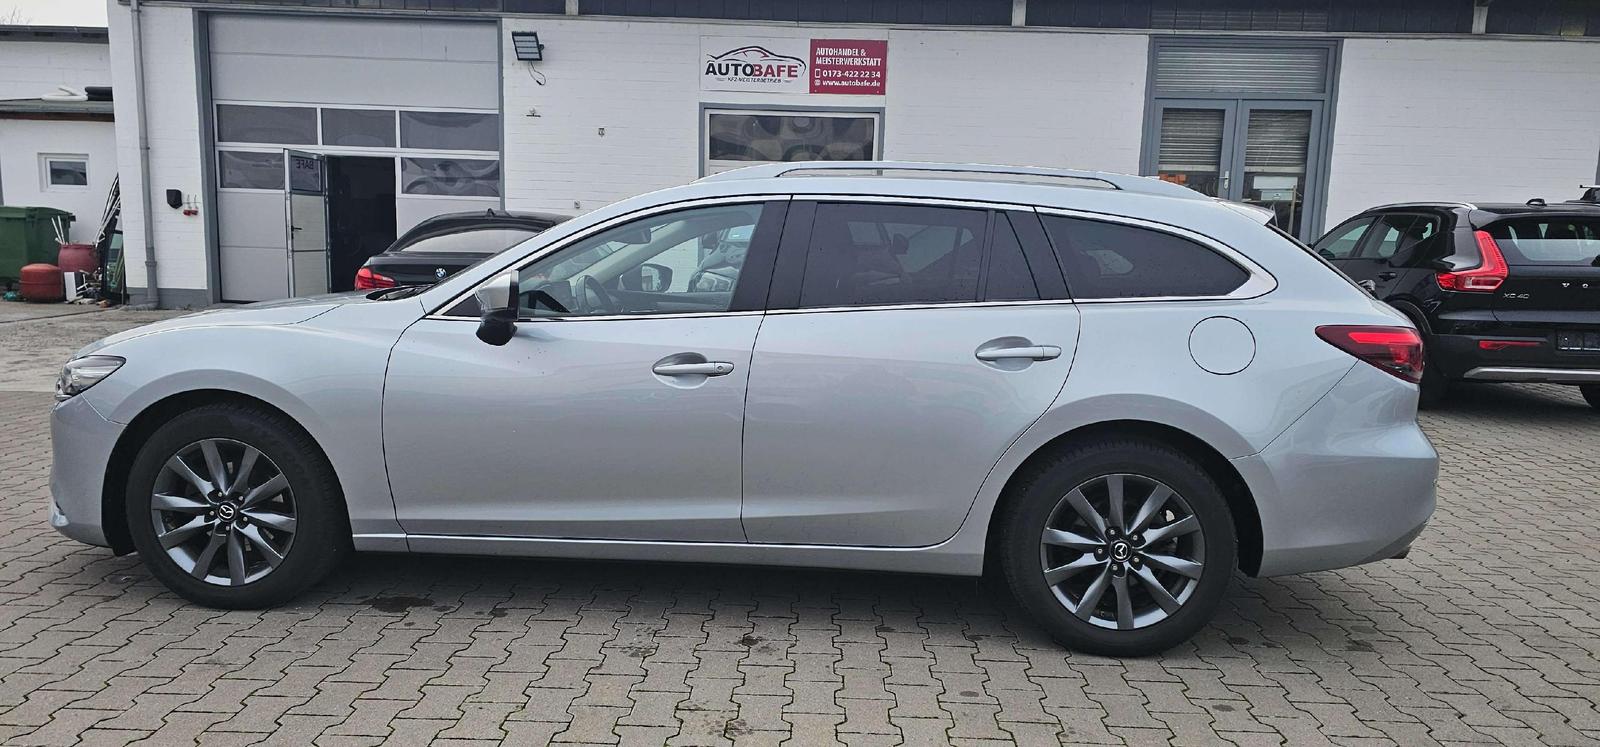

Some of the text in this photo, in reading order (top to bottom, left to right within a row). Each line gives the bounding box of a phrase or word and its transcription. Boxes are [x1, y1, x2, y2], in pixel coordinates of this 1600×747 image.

[815, 47, 859, 56] AUTOHANDEL
[815, 57, 881, 66] MEISTERWERKSTATT
[704, 62, 798, 77] AUTOBAFE
[822, 69, 859, 77] 0173-422
